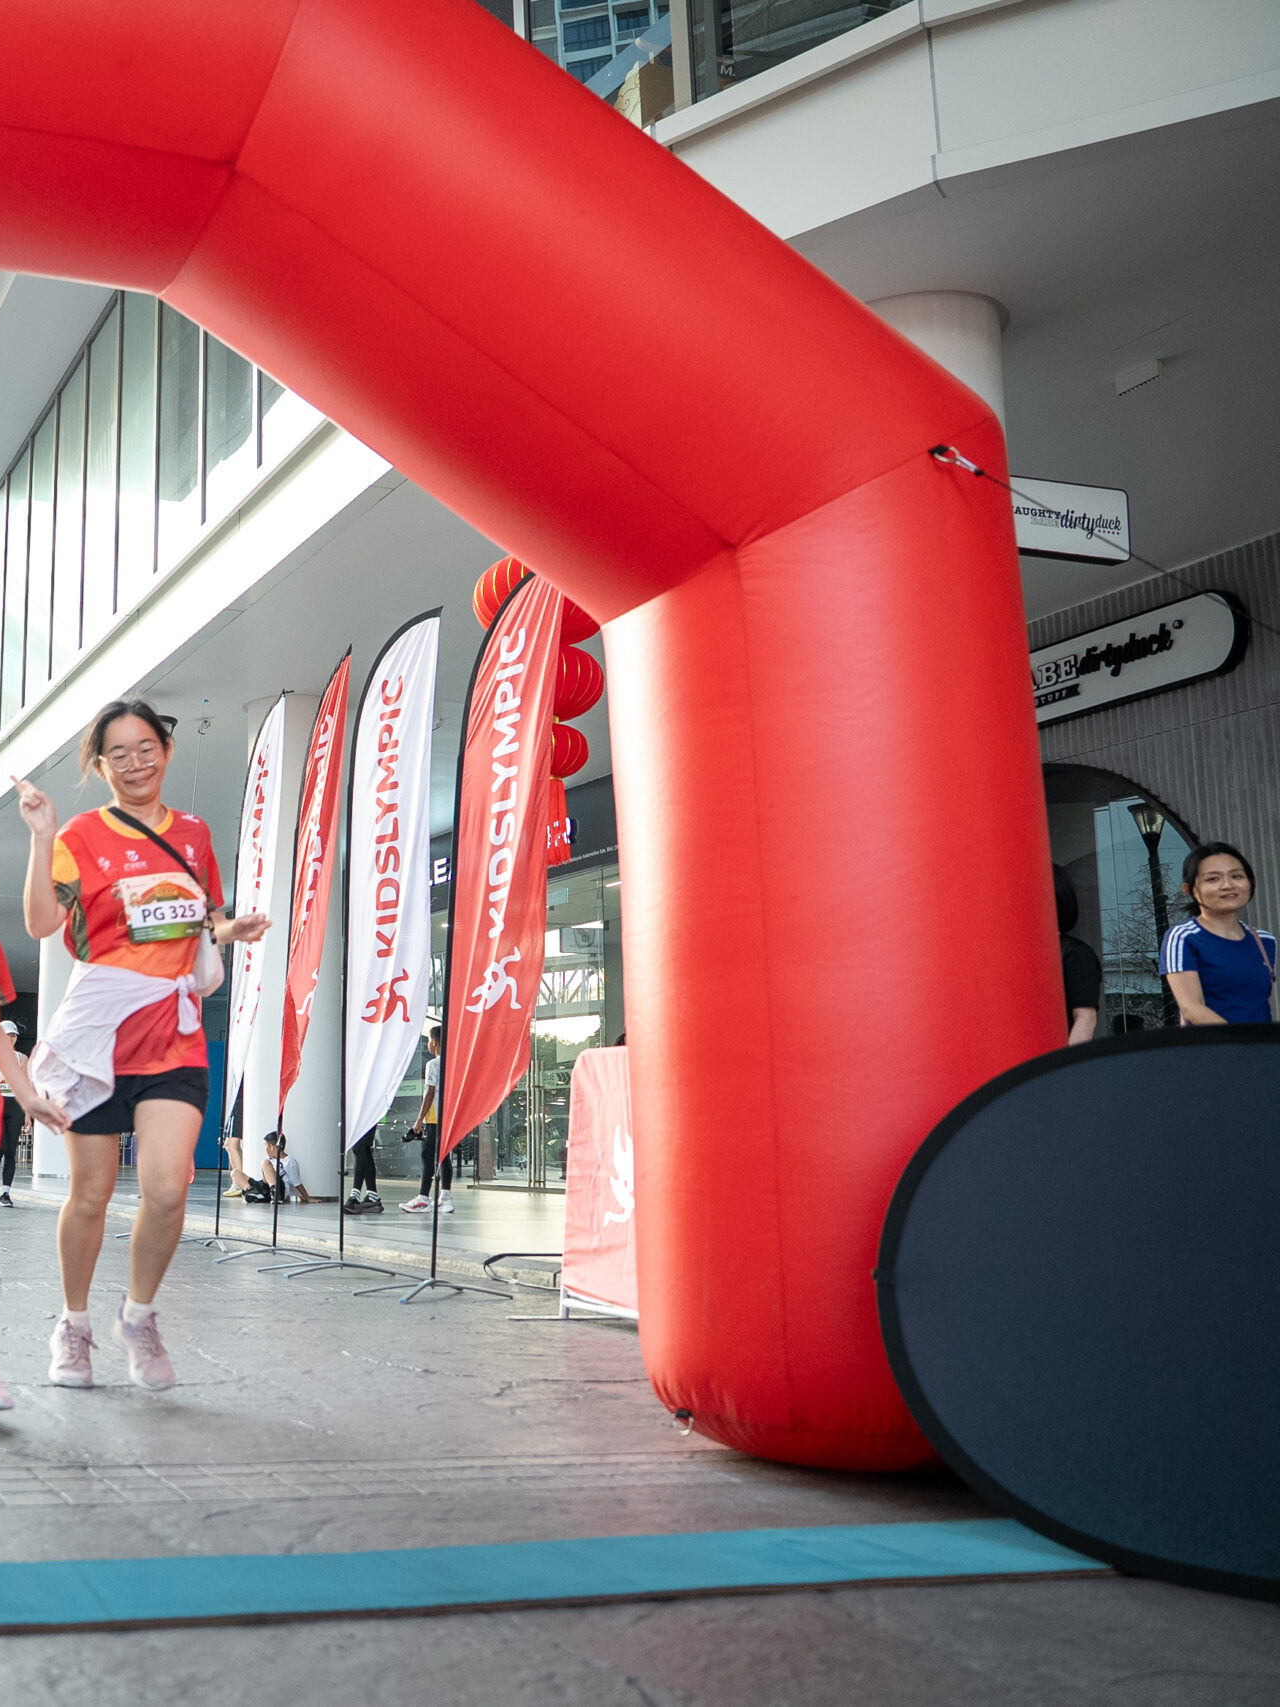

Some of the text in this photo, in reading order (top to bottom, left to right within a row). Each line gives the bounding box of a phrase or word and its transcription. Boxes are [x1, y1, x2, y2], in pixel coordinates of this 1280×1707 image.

[1012, 506, 1061, 520] AUGHTY
[1031, 653, 1079, 691] BE
[488, 627, 526, 940] KIDSLYMPIC
[374, 674, 404, 959] KIDSLYMPIC
[142, 904, 196, 923] PG 325
